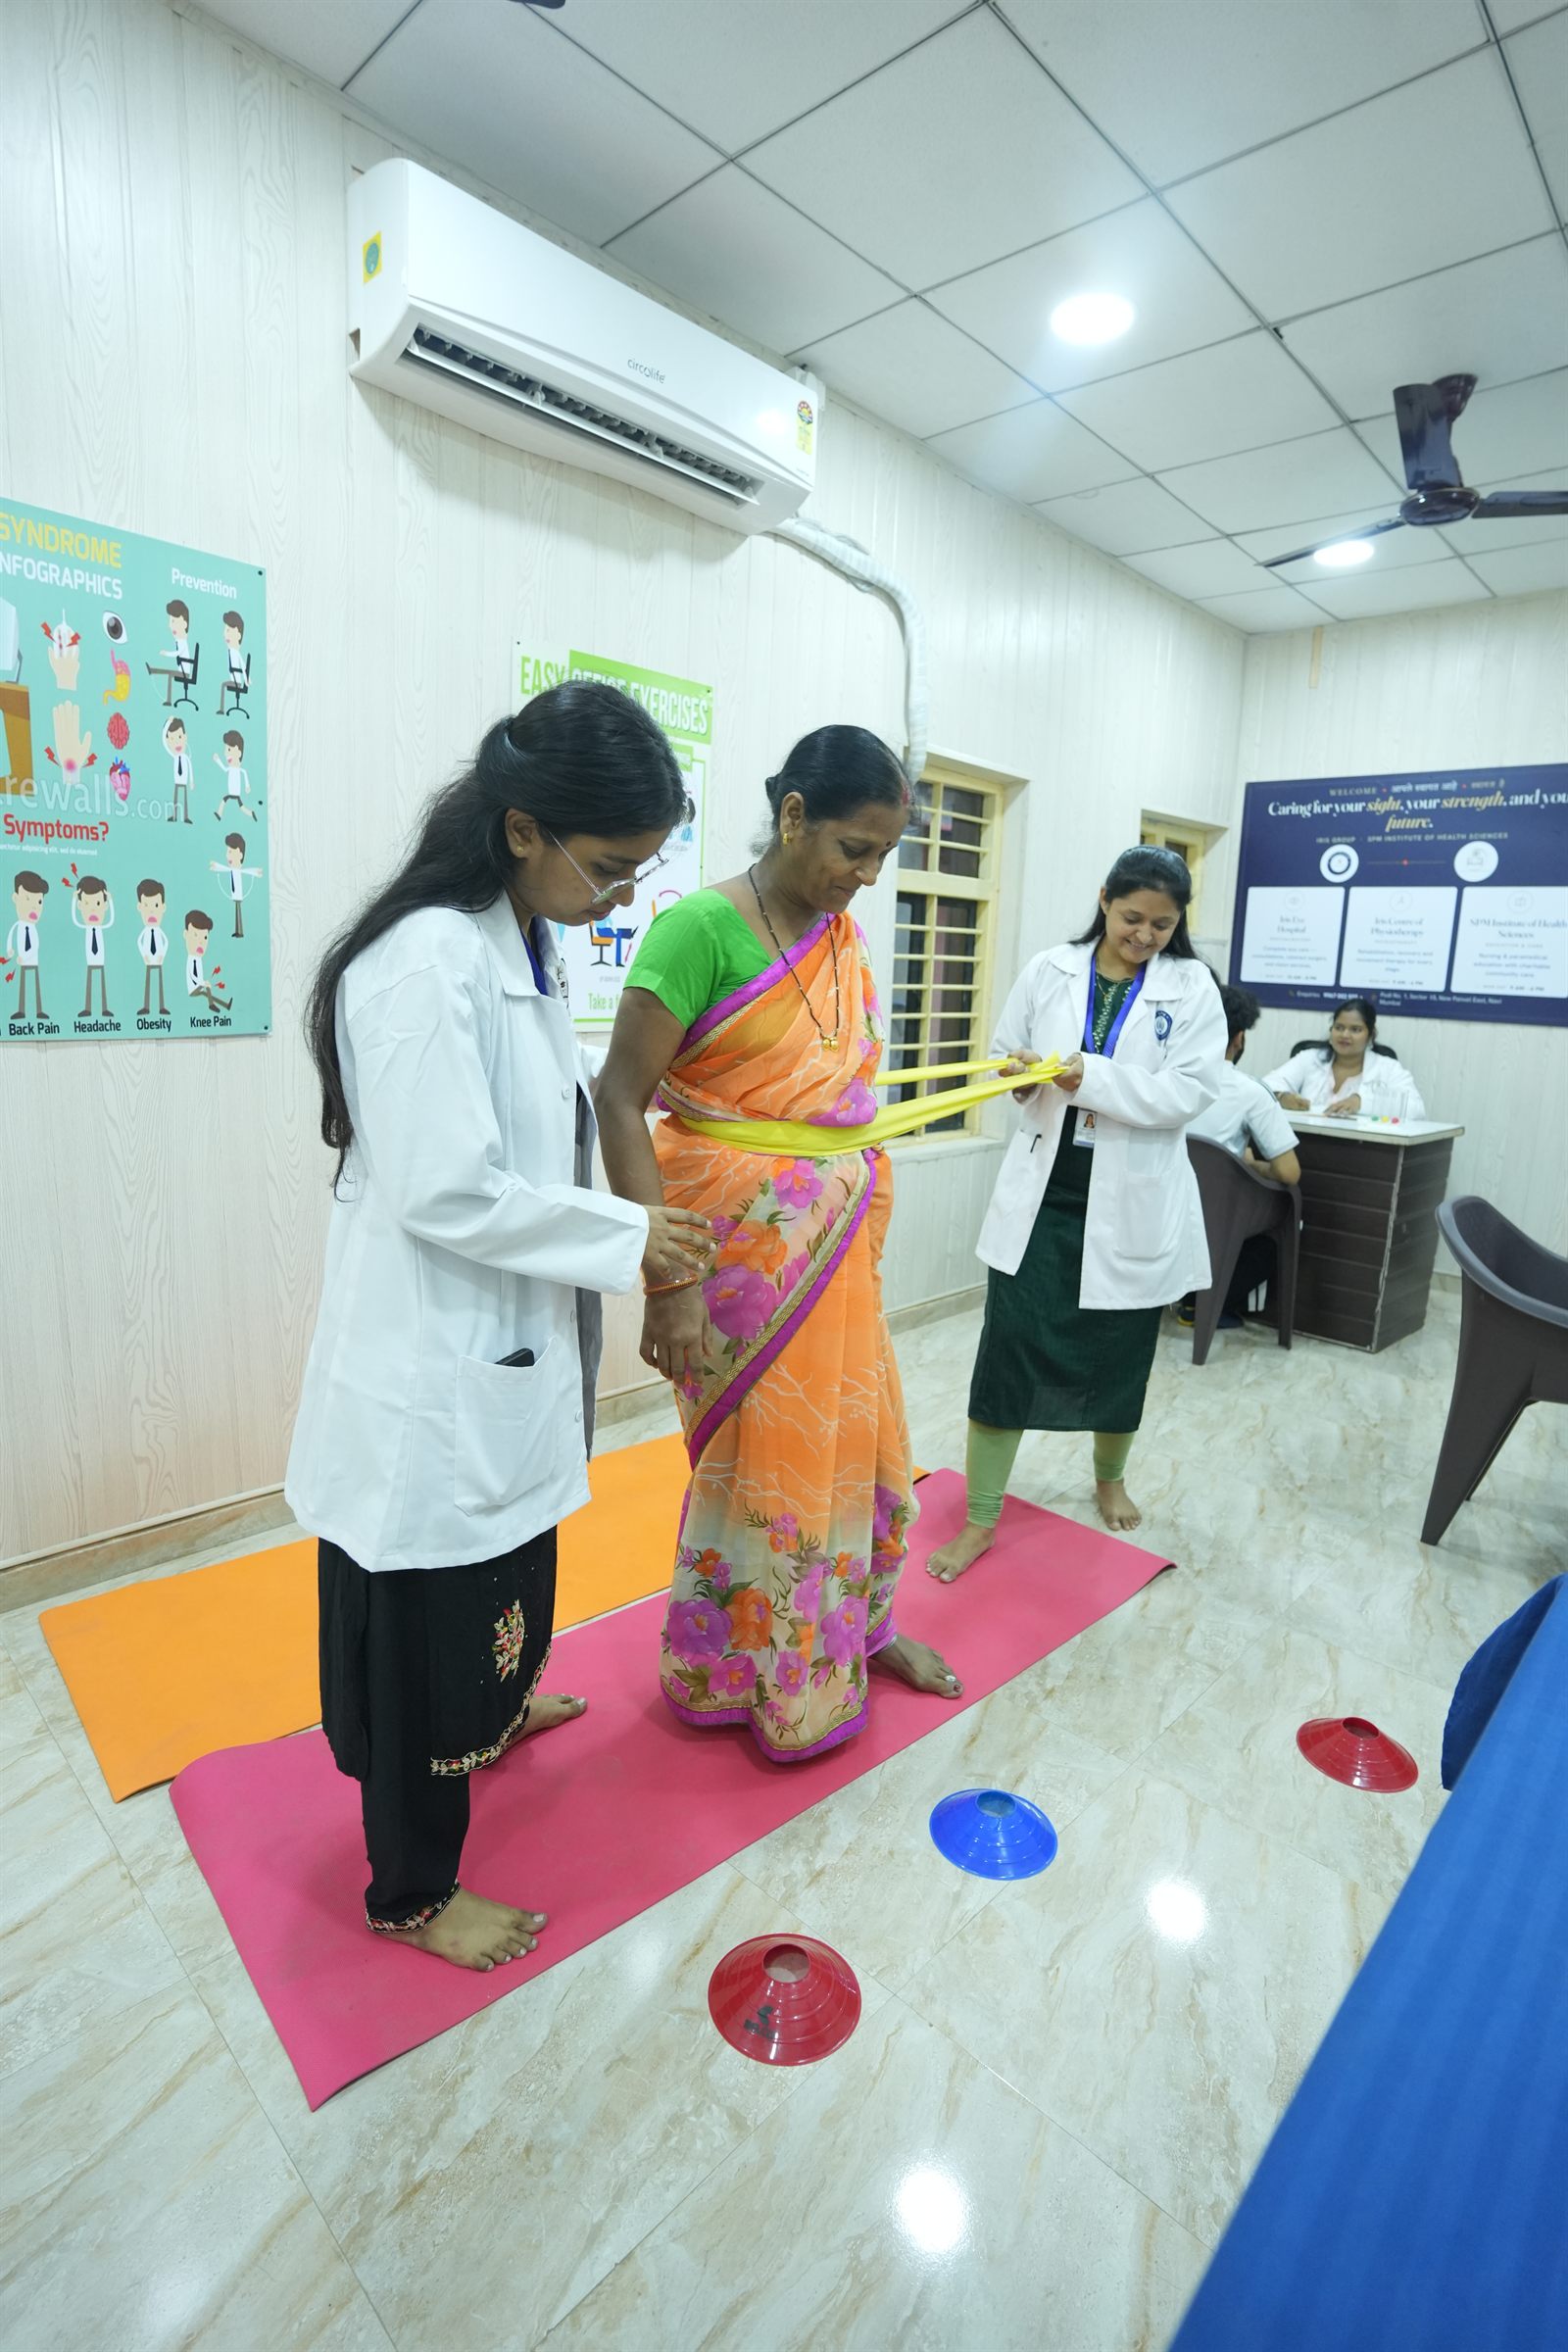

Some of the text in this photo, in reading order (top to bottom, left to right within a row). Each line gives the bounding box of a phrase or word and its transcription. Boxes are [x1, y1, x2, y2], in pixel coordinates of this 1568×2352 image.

[0, 513, 122, 568] SYNDROME
[172, 567, 237, 599] Prevention
[521, 656, 565, 696] EASY
[0, 773, 184, 821] rewalls.com
[1329, 787, 1377, 796] WELCOME
[1268, 802, 1312, 818] Caring
[1312, 799, 1334, 814] for
[1333, 801, 1366, 817] your
[1404, 799, 1441, 814] your
[1509, 788, 1541, 806] and
[3, 813, 109, 844] Symptoms?
[1385, 814, 1434, 833] future.
[588, 993, 608, 1010] Take
[610, 998, 614, 1010] a
[8, 1022, 60, 1036] Back Pain
[74, 1018, 122, 1033] Headache
[136, 1017, 172, 1033] Obesity
[189, 1015, 232, 1028] Knee Pain
